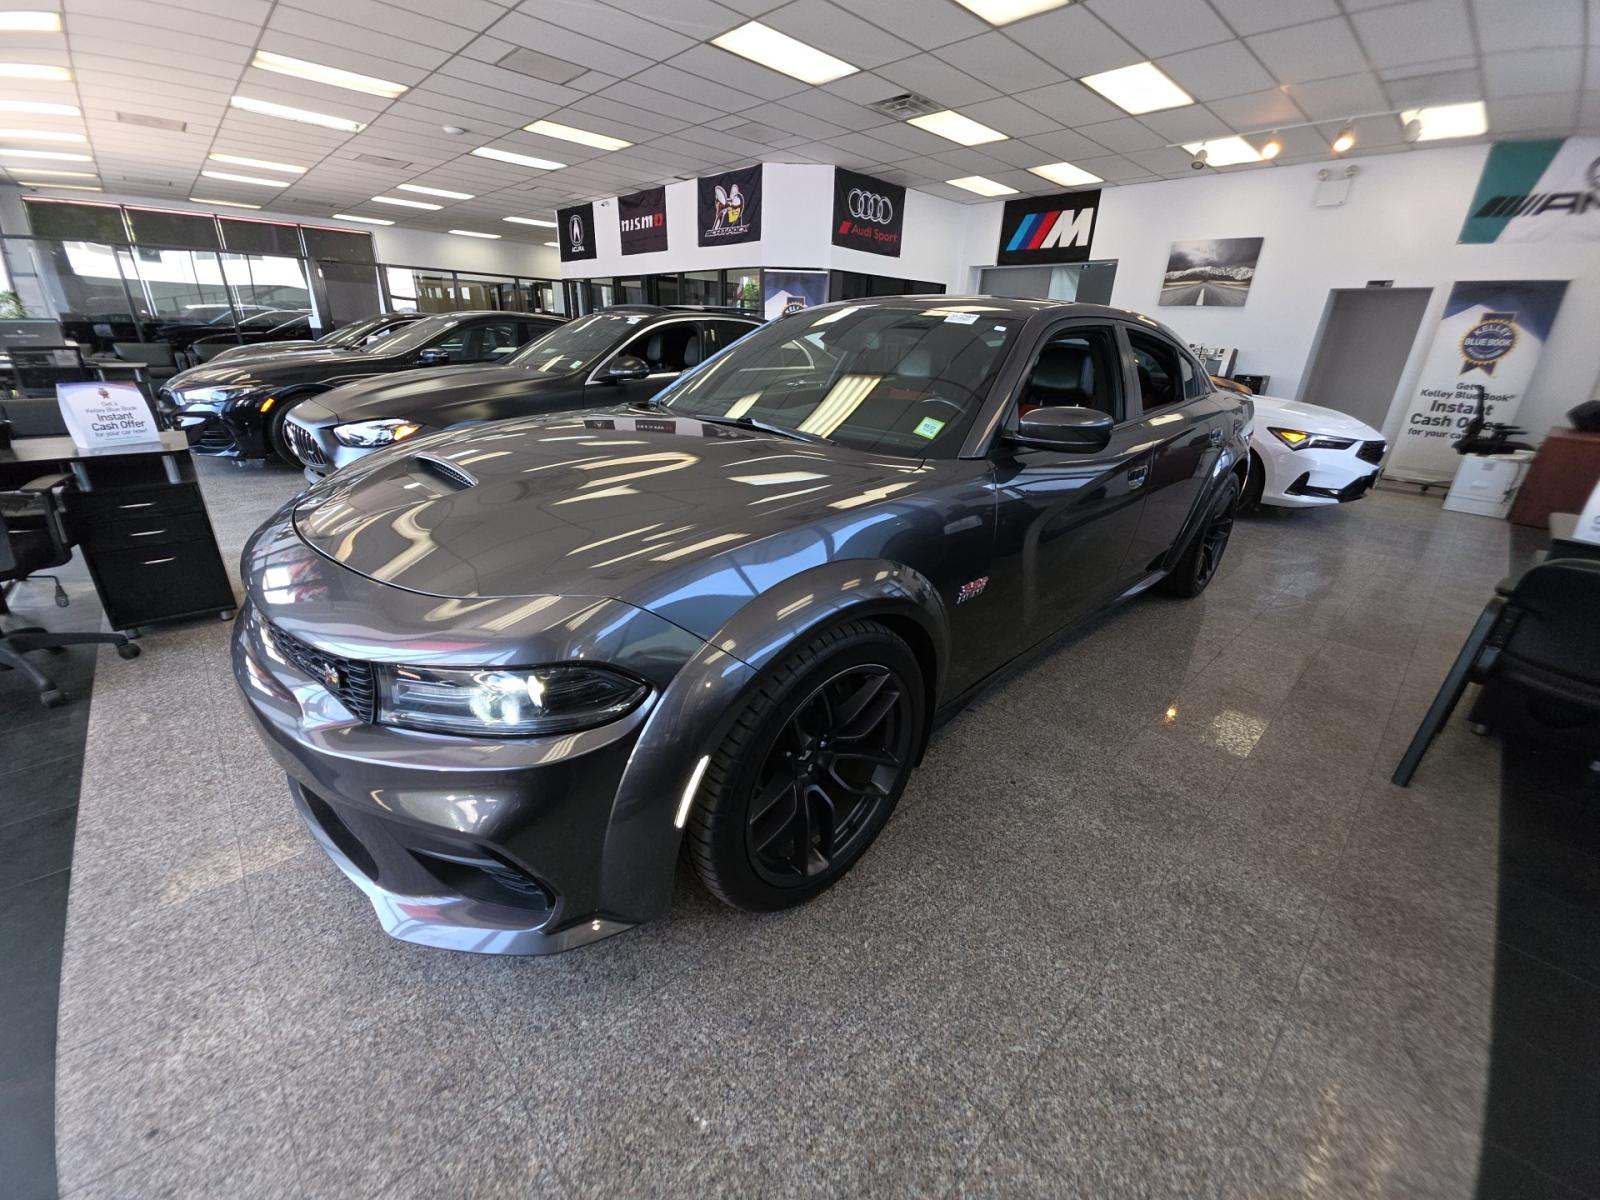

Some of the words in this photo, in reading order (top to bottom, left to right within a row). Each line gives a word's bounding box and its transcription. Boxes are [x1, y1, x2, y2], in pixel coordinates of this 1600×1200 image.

[851, 224, 872, 237] Audi
[874, 229, 898, 242] Sport
[1474, 324, 1513, 337] KELLEY
[1464, 338, 1486, 346] BLUE
[1487, 338, 1512, 346] BOOK
[1420, 389, 1453, 399] Kelley
[1455, 392, 1478, 400] Blue
[97, 412, 134, 422] Instant
[1410, 413, 1452, 427] Cash
[91, 422, 119, 431] Cash
[120, 419, 145, 429] Offer
[1425, 430, 1448, 438] your
